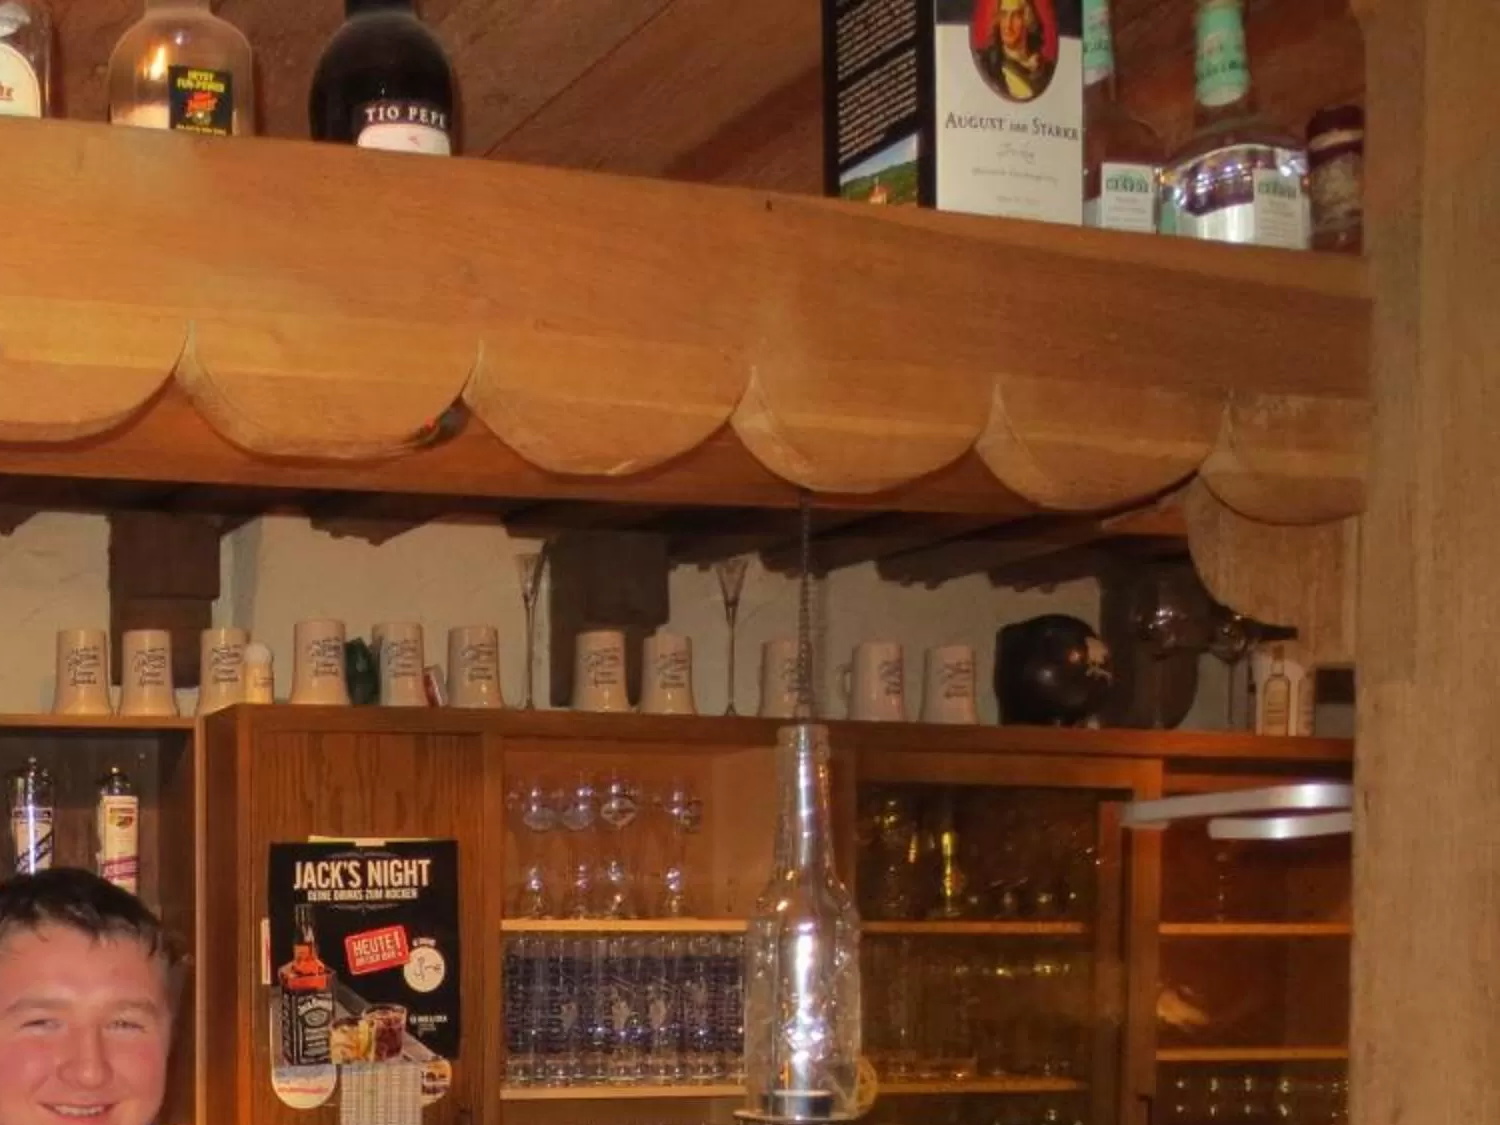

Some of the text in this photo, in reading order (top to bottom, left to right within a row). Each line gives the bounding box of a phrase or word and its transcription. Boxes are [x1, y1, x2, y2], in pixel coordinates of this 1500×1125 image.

[365, 105, 399, 121] TIO
[945, 111, 1005, 132] AUGUST
[294, 859, 431, 890] JACK'S NIGHT
[352, 931, 403, 957] HEUTE!
